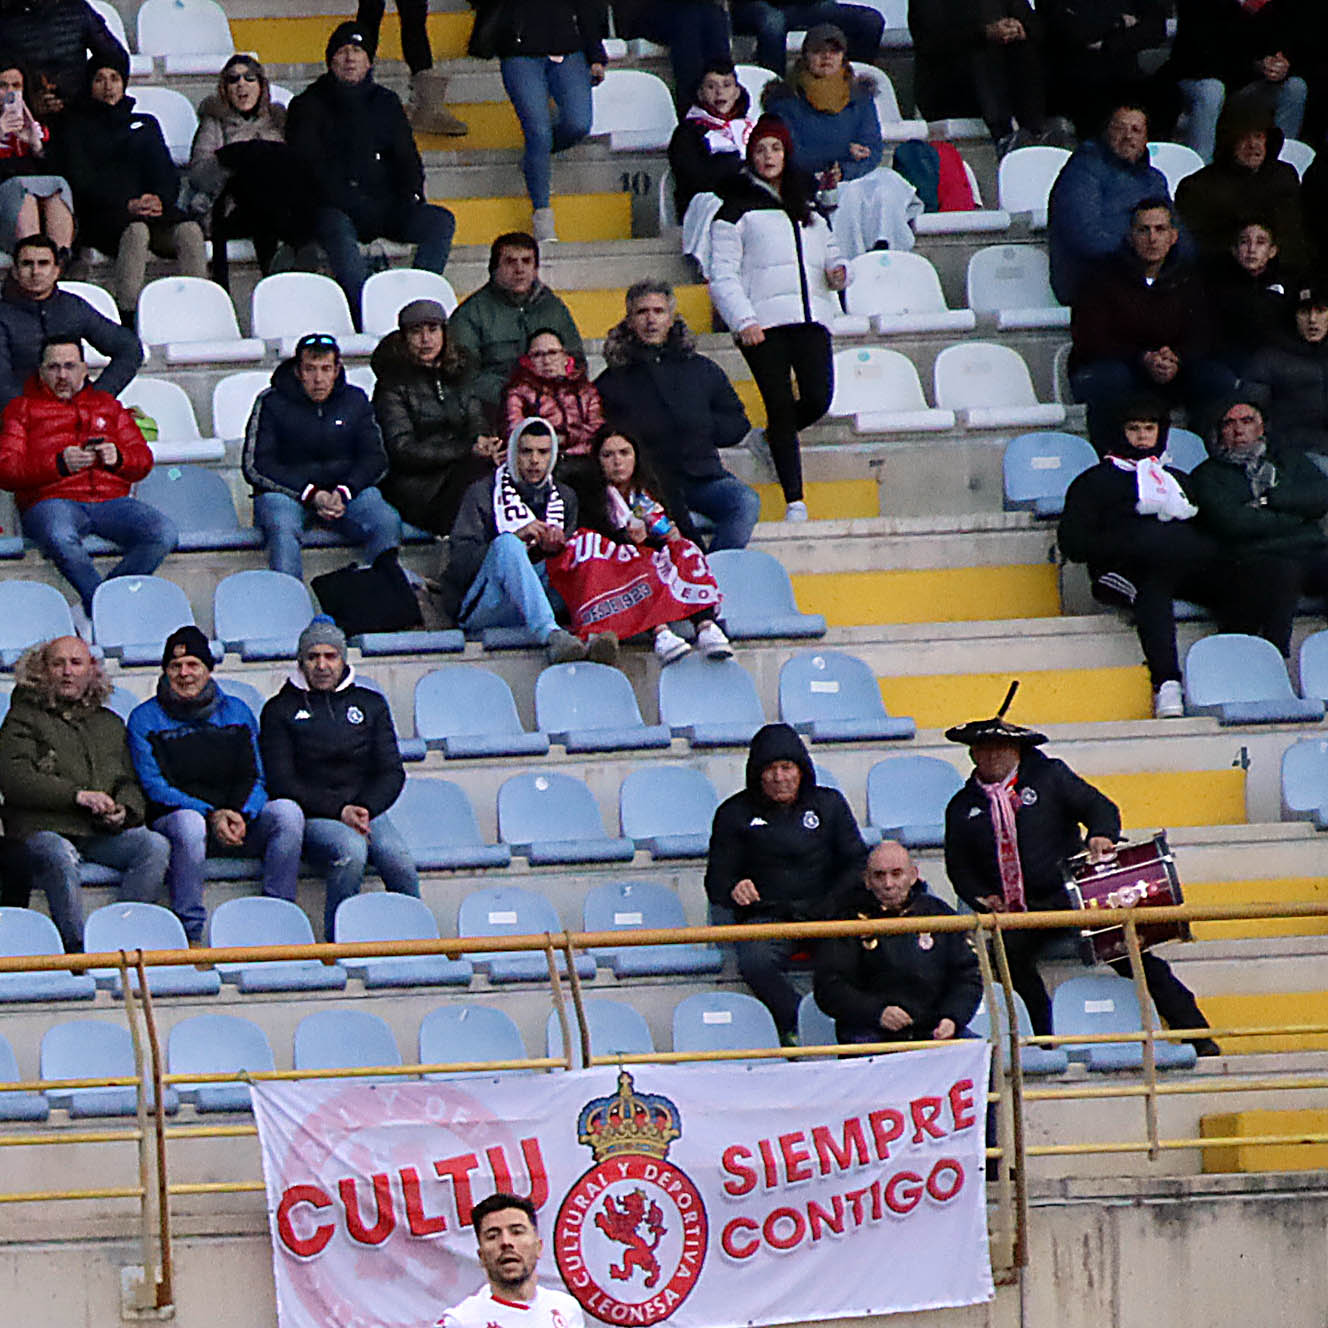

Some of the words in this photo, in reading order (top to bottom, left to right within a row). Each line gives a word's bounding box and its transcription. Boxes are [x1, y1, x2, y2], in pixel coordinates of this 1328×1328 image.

[721, 1078, 977, 1196] SIEMPRE
[276, 1137, 549, 1258] CULTU
[562, 1173, 608, 1288] CULTURAL
[617, 1162, 630, 1178] Y
[643, 1163, 702, 1279] DEPORTIVA
[721, 1158, 966, 1260] CONTIGO
[586, 1287, 682, 1323] LEONESA
